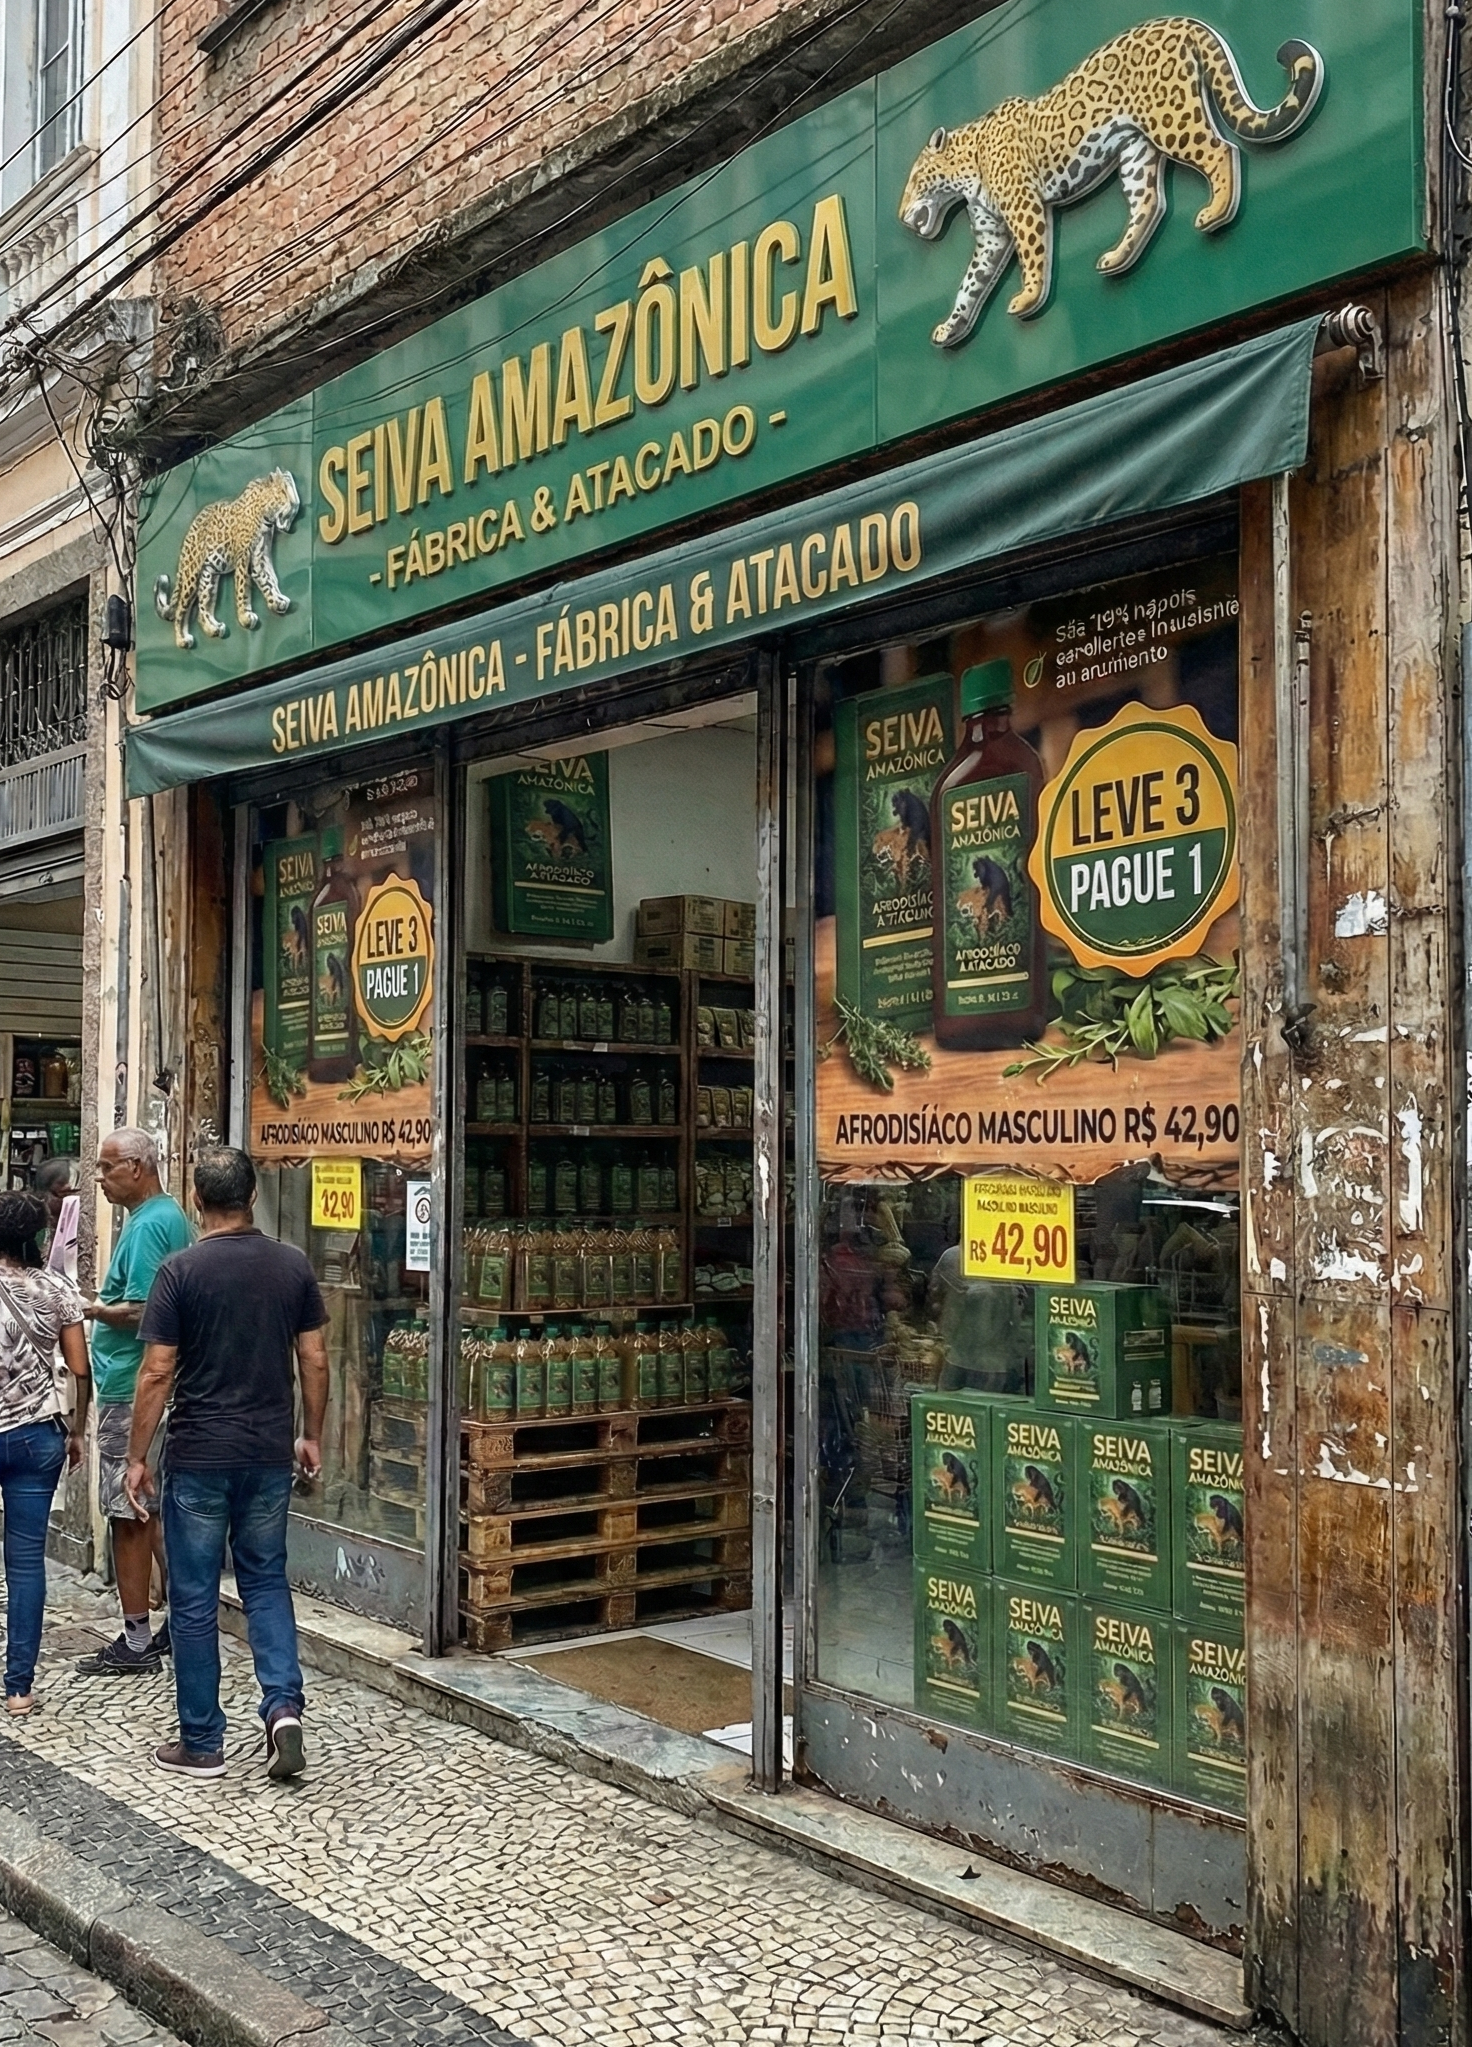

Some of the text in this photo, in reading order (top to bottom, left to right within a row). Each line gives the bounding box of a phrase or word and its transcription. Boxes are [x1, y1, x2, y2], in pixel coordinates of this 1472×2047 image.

[319, 193, 858, 545] SEIVA AMAZÔNICA
[386, 499, 526, 589] FÁBRICA
[530, 486, 557, 532] &
[563, 405, 757, 522] ATACADO
[271, 688, 339, 754] SEIVA
[345, 649, 506, 727] AMAZÔNICA
[536, 584, 678, 681] FÁBRICA
[689, 571, 715, 633] &
[725, 501, 922, 625] ATACADO
[866, 706, 944, 760] SEIVA
[951, 790, 1020, 833] SEIVA
[1072, 763, 1200, 847] LEVE 3
[1071, 842, 1202, 913] PAGUE 1
[367, 917, 404, 958] LEVE
[408, 915, 418, 953] 3
[366, 964, 419, 1000] PAGUE 1
[321, 1121, 380, 1145] MASCULINO
[382, 1117, 396, 1149] R$
[398, 1118, 431, 1149] 42,90
[978, 1107, 1116, 1144] MASCULINO
[1124, 1101, 1157, 1148] R$
[1164, 1103, 1240, 1151] 42,90
[970, 1222, 1068, 1275] R$ 42,90
[1050, 1296, 1096, 1318] SEIVA
[926, 1411, 976, 1438] SEIVA
[1007, 1422, 1061, 1450] SEIVA
[1093, 1434, 1152, 1463] SEIVA
[928, 1576, 976, 1608] SEIVA
[1009, 1597, 1062, 1627] SEIVA
[1096, 1616, 1153, 1650] SEIVA
